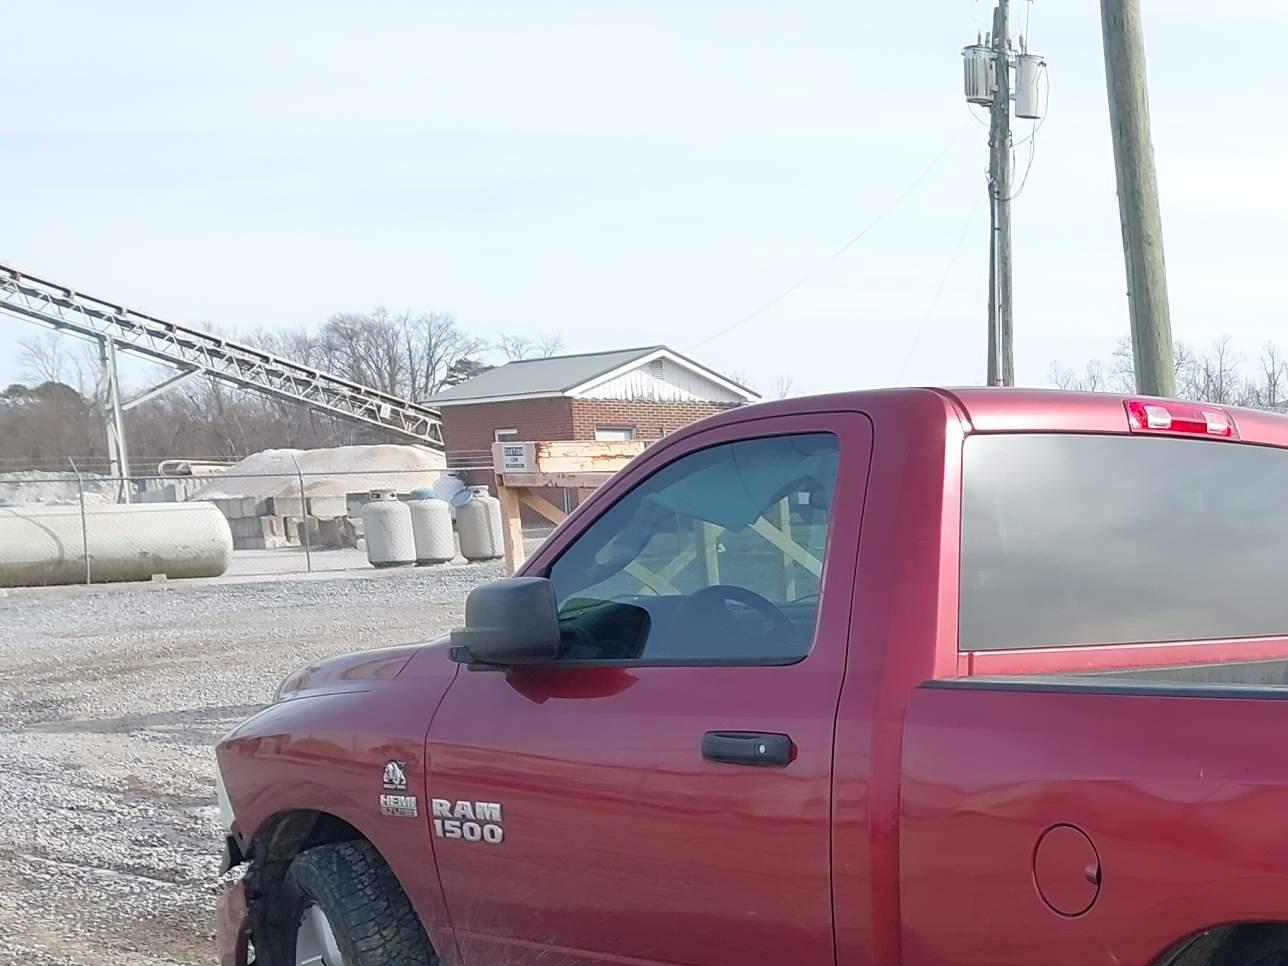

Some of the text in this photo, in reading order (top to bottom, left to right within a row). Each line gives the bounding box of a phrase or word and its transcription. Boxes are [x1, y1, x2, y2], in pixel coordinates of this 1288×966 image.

[380, 795, 416, 809] HEMI
[432, 799, 501, 821] RAM
[434, 819, 503, 844] 1500
